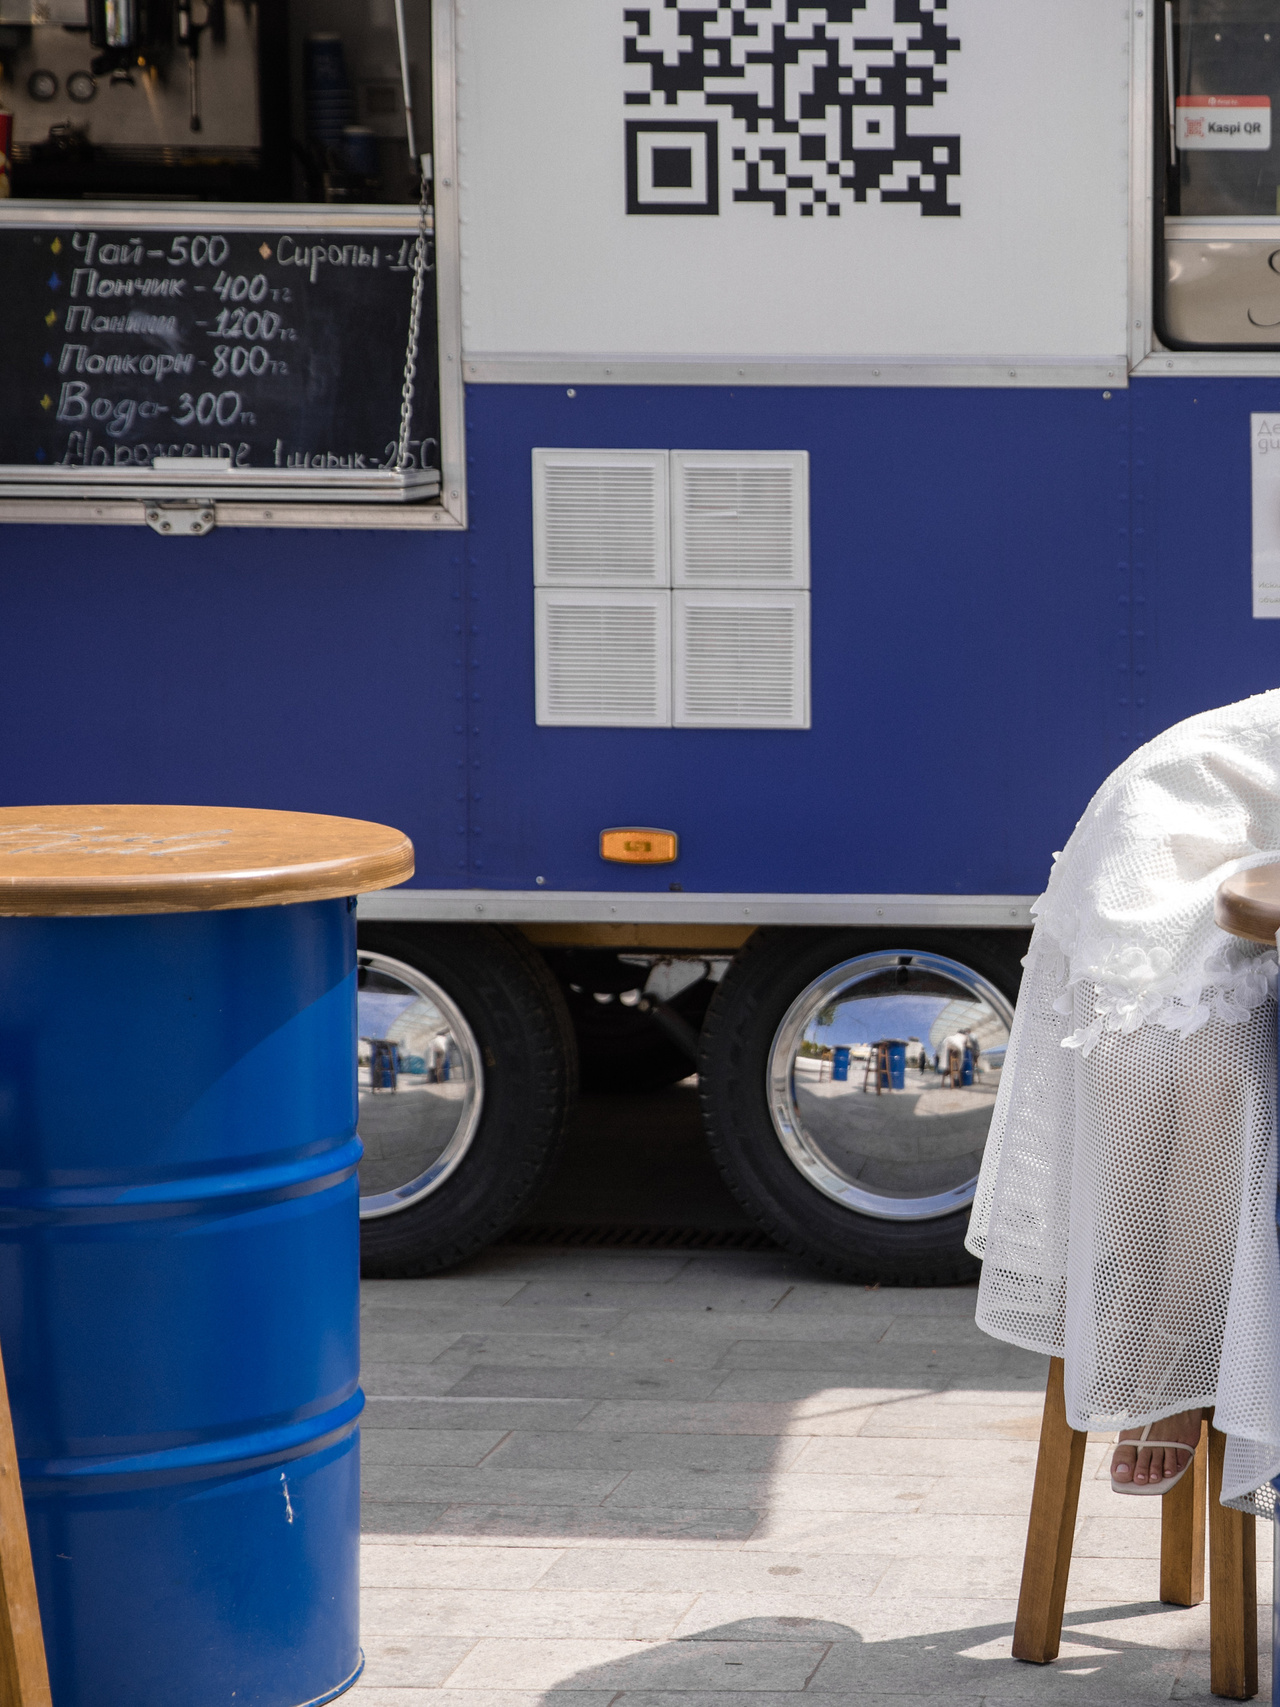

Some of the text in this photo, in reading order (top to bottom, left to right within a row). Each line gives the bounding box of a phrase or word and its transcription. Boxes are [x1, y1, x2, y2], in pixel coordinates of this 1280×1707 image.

[1208, 121, 1261, 135] Kaspi QR
[276, 235, 379, 284] Сиропы
[70, 268, 186, 298] Пончик
[57, 343, 196, 382] Попкорн
